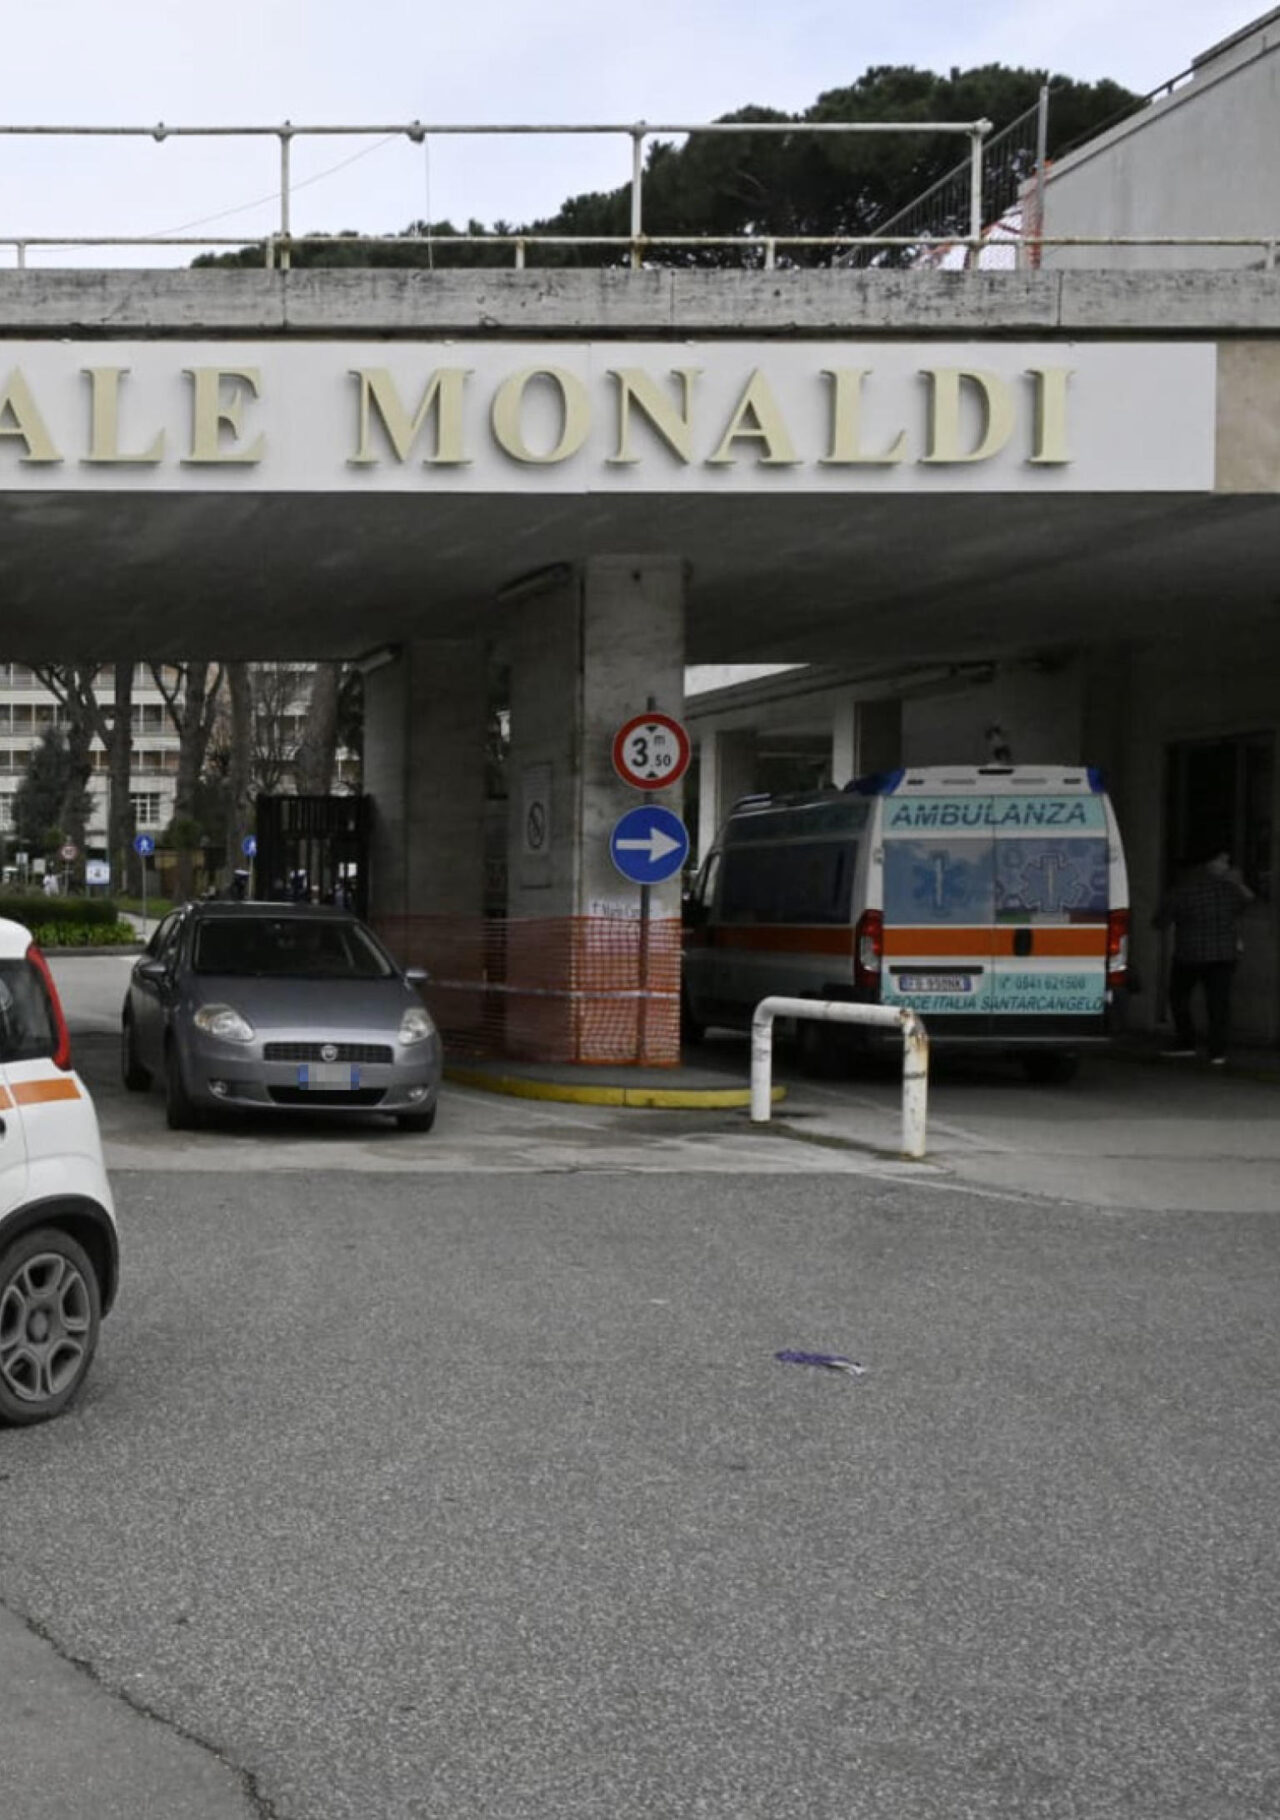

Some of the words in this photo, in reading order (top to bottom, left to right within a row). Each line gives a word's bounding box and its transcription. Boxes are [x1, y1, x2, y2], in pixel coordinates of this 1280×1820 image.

[345, 366, 1076, 468] MONALDI
[890, 802, 1087, 826] AMBULANZA
[931, 996, 977, 1010] ITALIA
[981, 995, 1105, 1011] SANTARCANGELO
